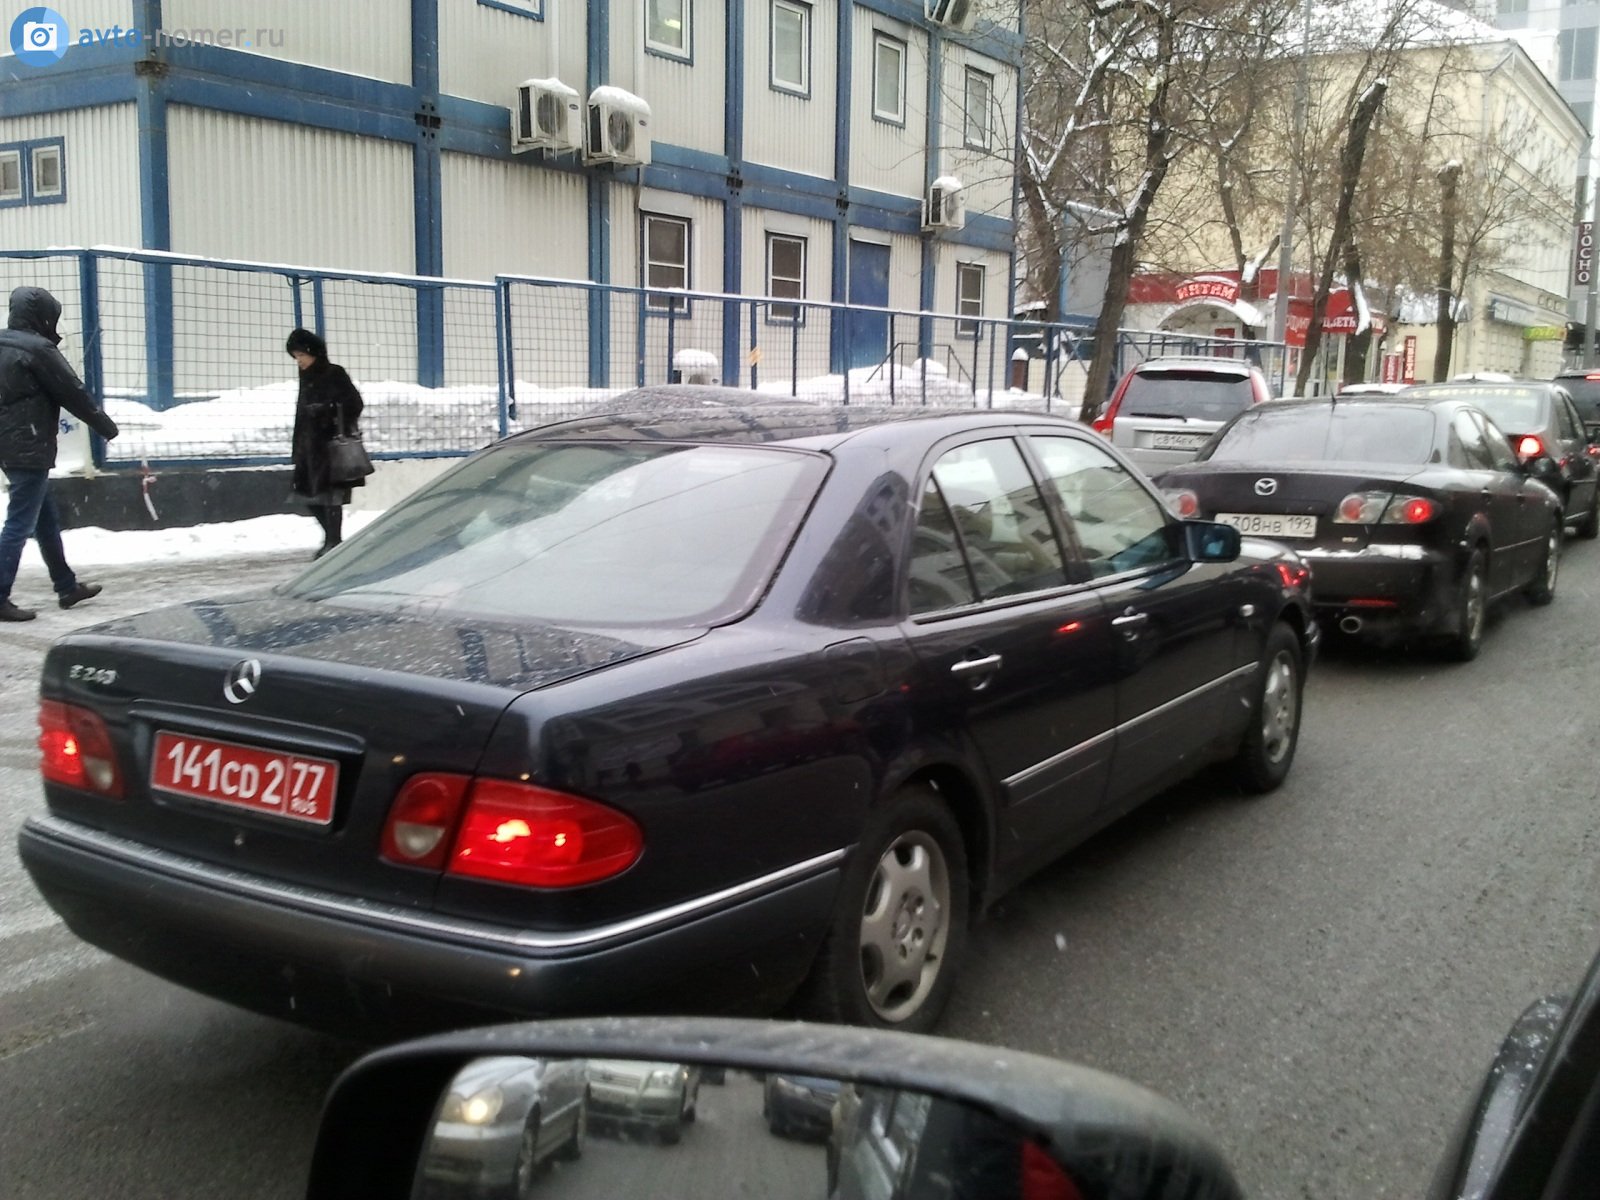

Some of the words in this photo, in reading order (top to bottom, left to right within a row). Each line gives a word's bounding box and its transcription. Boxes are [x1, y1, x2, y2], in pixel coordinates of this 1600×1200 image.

[1176, 282, 1236, 300] ИНТИМ
[1222, 516, 1282, 533] 308HB
[292, 761, 326, 801] 77
